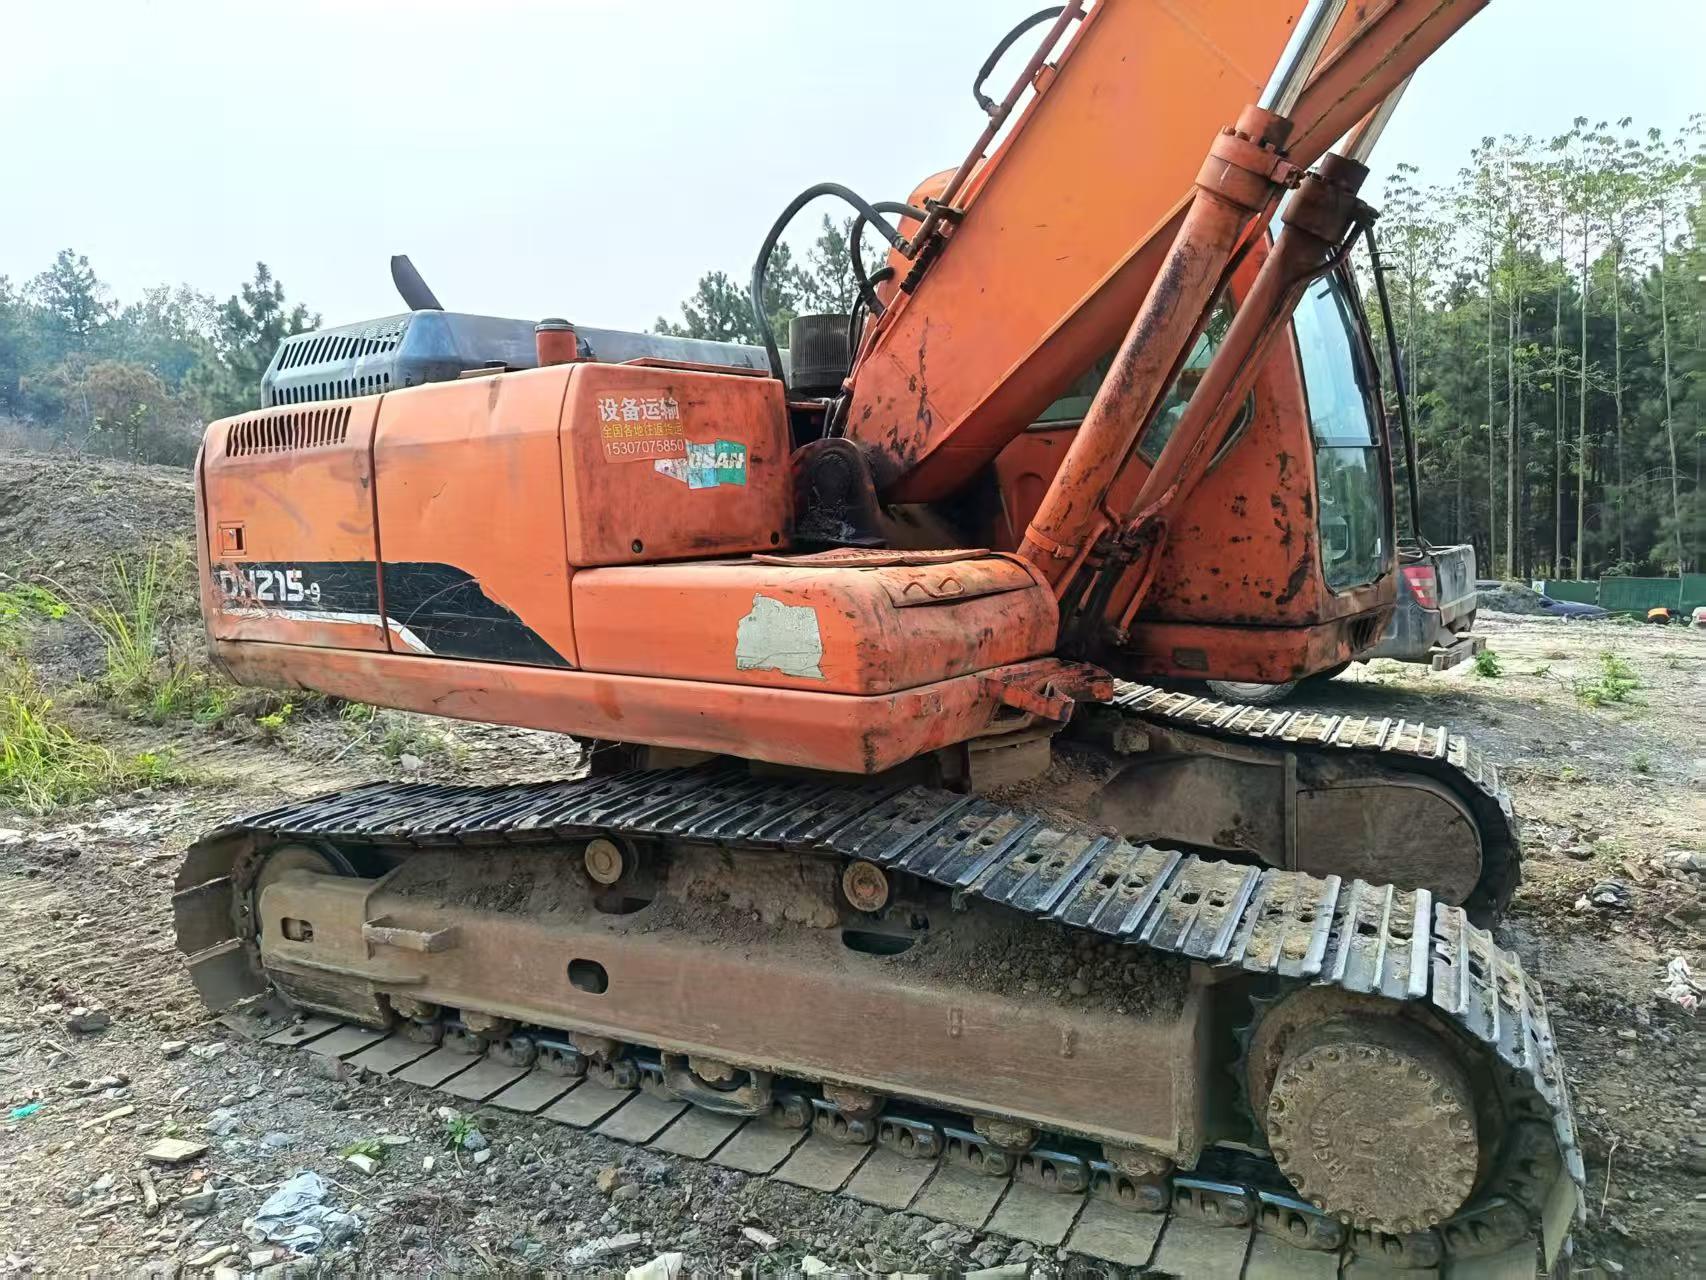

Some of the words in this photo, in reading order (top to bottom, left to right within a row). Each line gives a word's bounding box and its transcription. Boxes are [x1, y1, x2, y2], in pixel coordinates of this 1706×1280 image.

[598, 397, 680, 421] 设备运输
[605, 439, 684, 455] 15307075850
